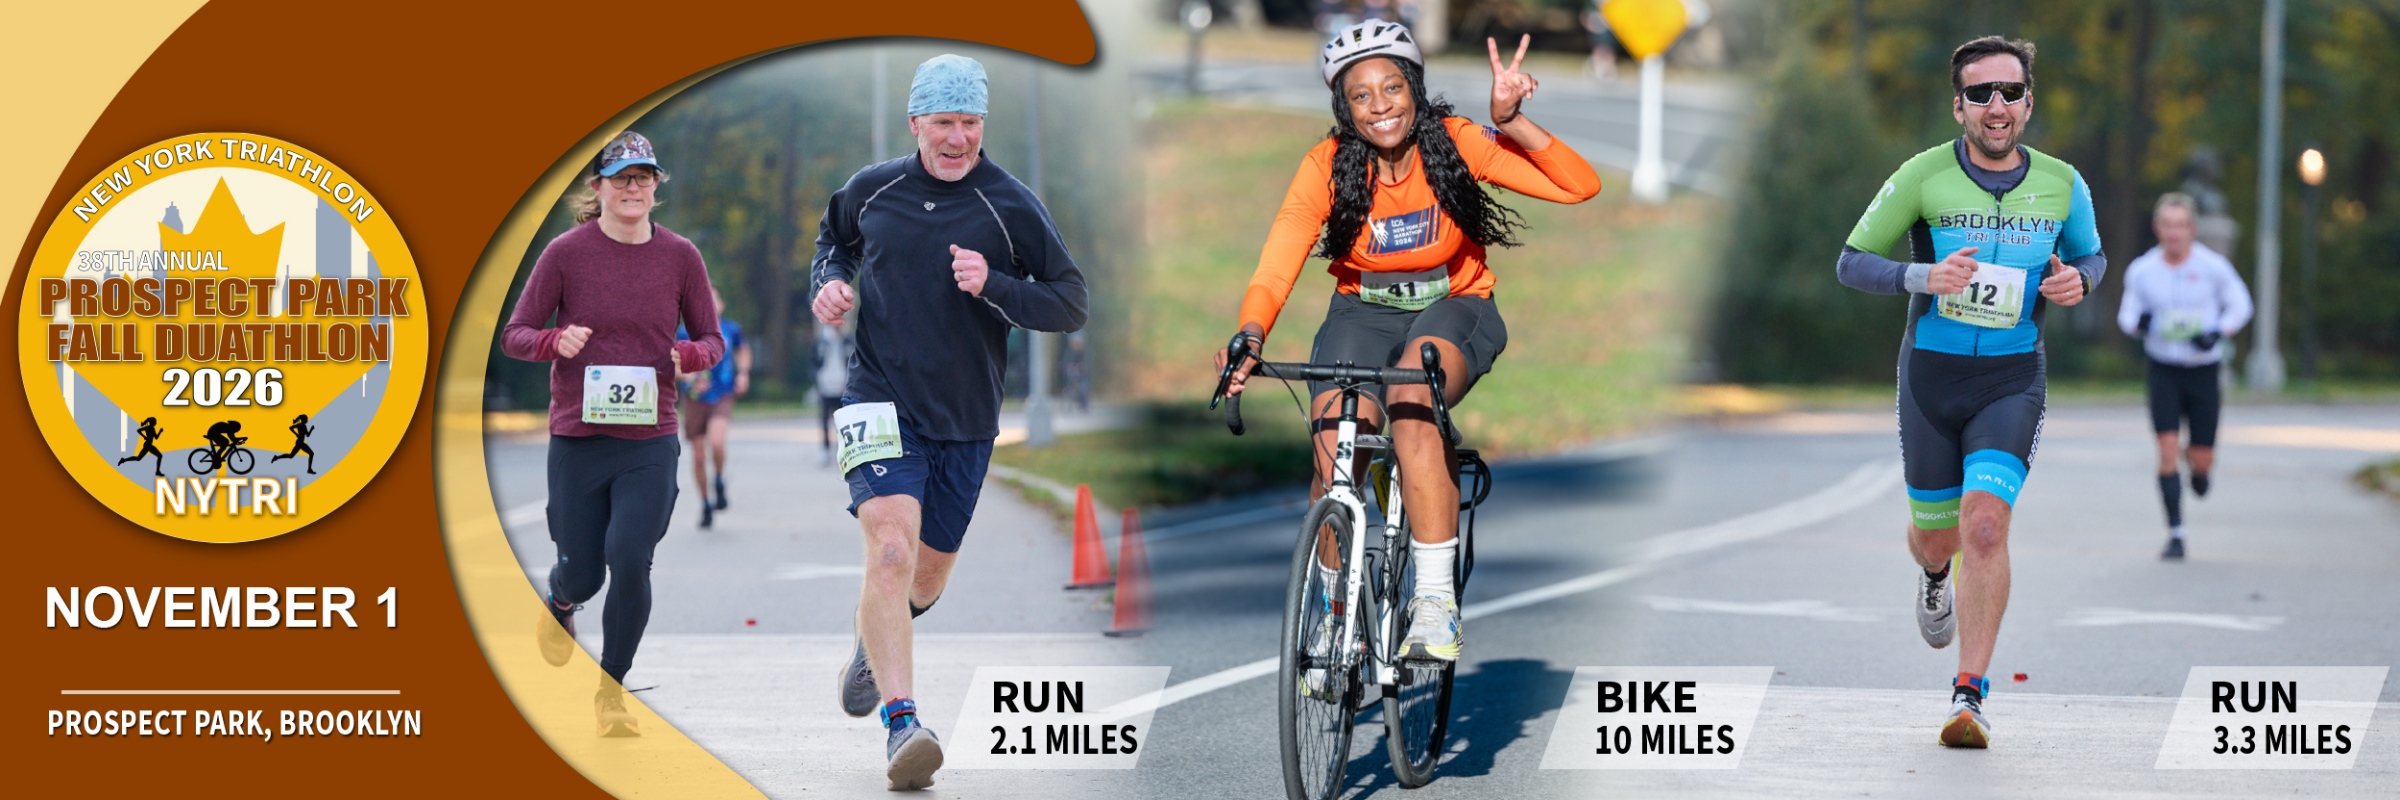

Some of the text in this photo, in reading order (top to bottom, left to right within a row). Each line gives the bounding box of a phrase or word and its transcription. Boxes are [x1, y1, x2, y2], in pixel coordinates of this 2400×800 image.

[1940, 213, 2056, 234] BROOKLYN
[1395, 237, 1412, 246] 2024
[1965, 231, 2032, 245] TRI CLUB
[1388, 282, 1416, 297] 41
[1970, 282, 1997, 306] 12
[609, 384, 635, 404] 32
[1977, 473, 2015, 493] VARLO
[1915, 509, 1959, 520] BROOKLYN
